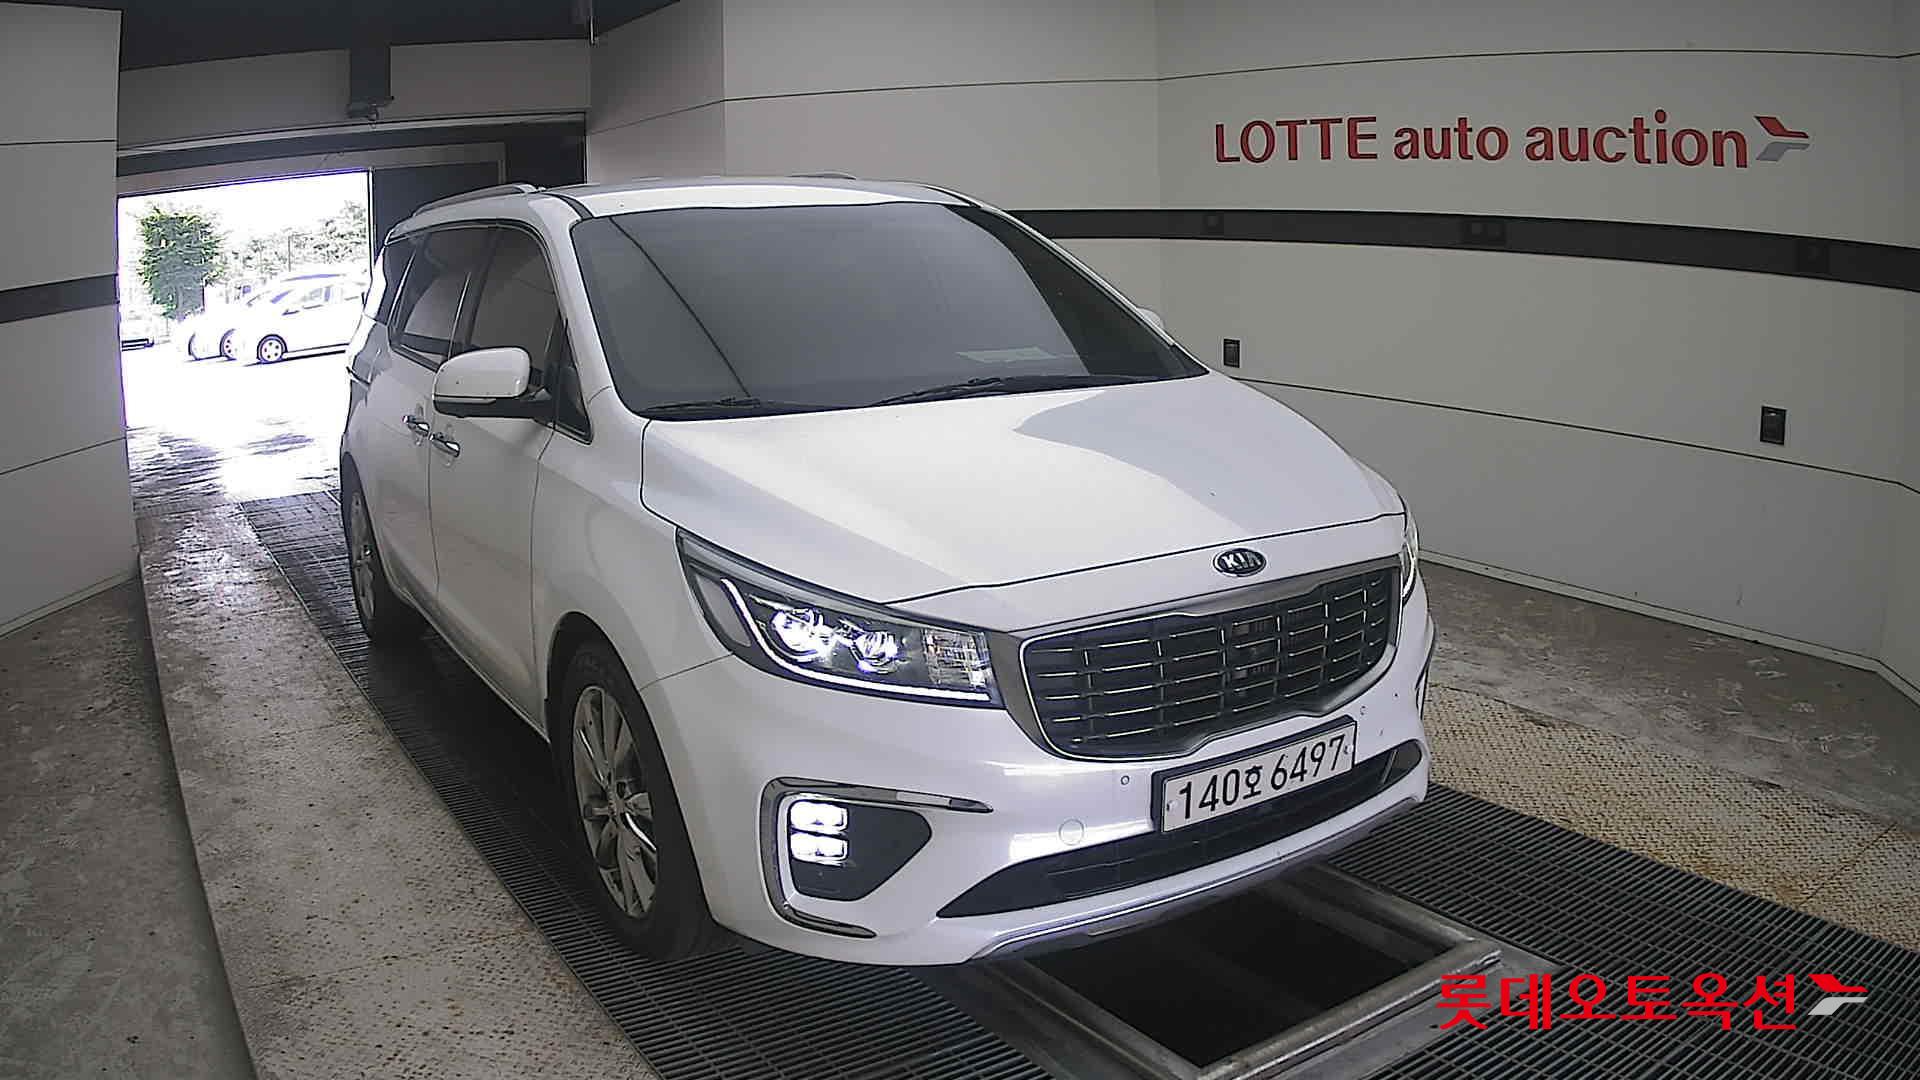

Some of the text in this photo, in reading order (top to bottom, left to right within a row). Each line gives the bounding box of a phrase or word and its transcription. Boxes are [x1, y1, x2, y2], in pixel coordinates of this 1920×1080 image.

[1214, 109, 1749, 168] LOTTE auto auction
[1221, 552, 1262, 569] KIA
[1270, 733, 1346, 791] 6497
